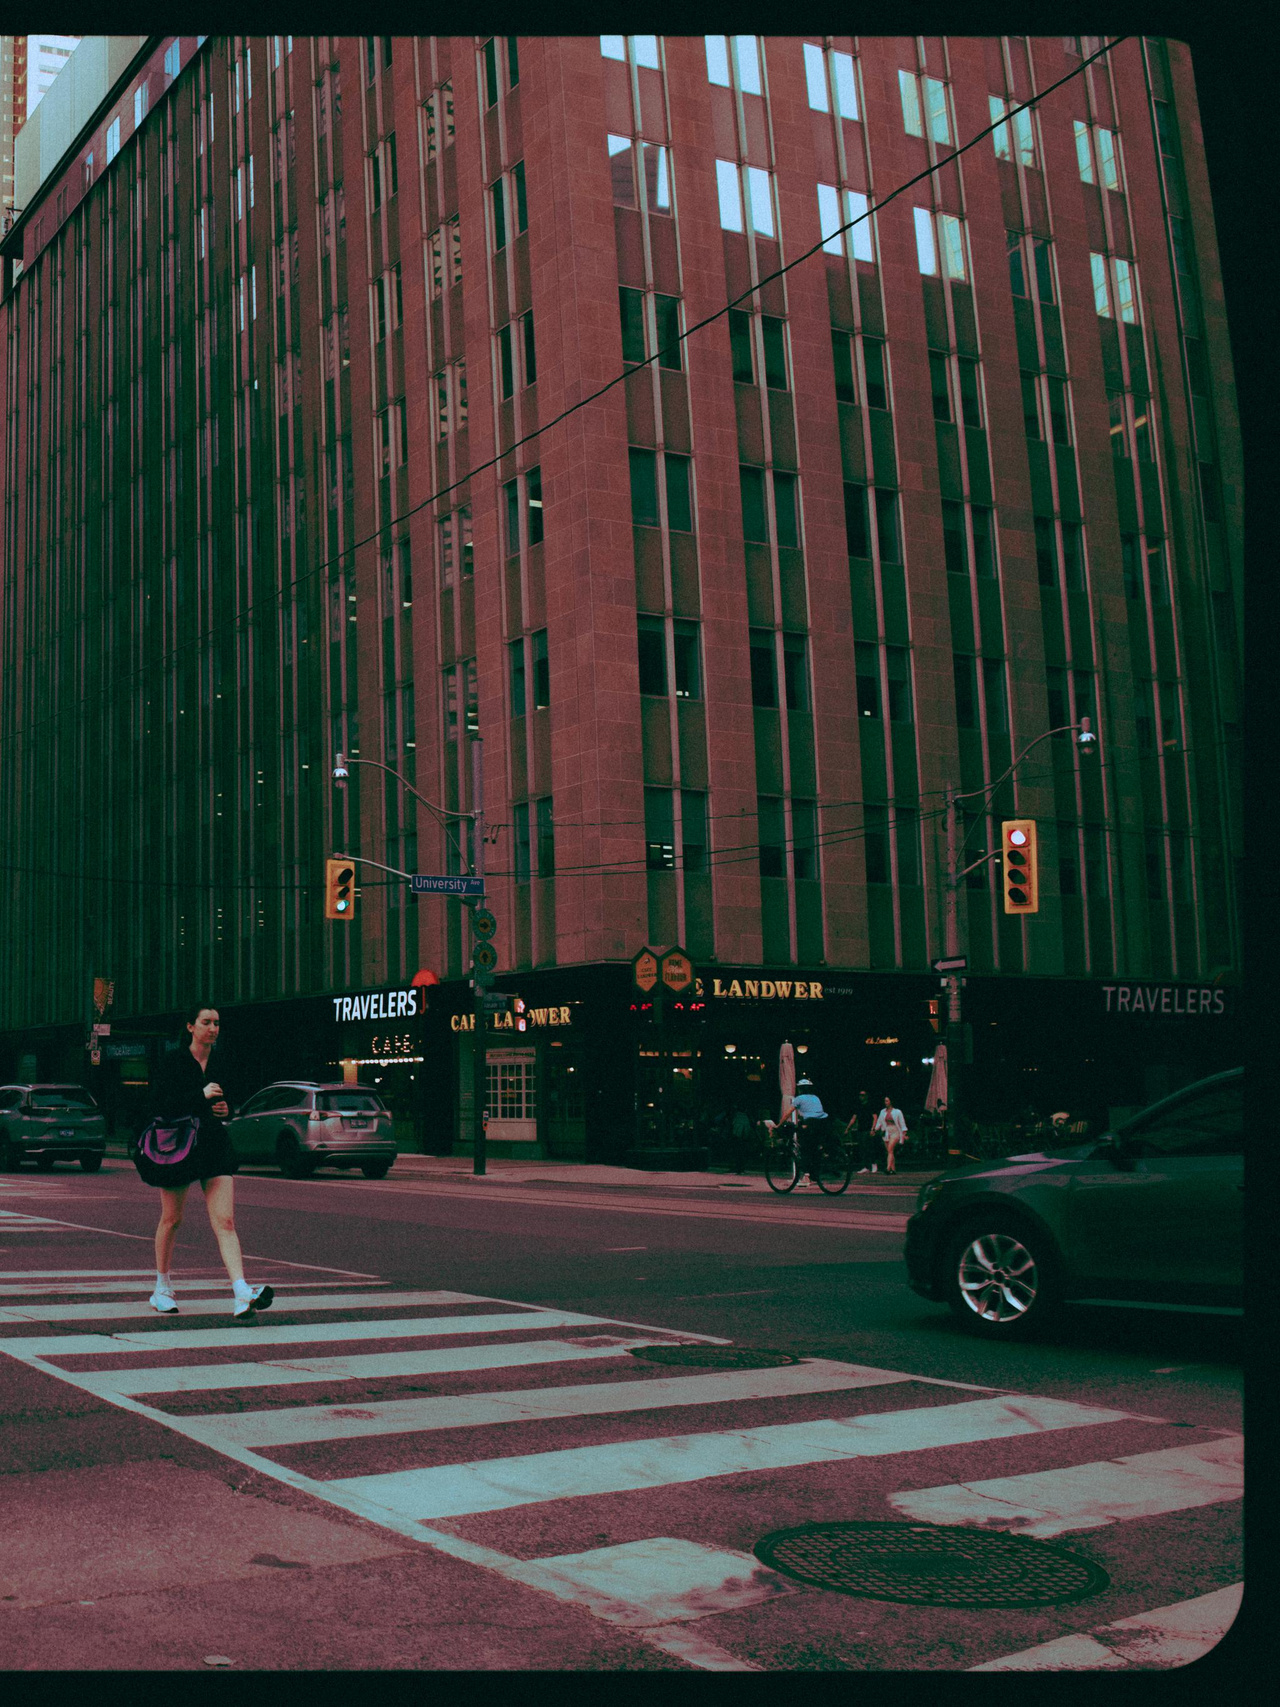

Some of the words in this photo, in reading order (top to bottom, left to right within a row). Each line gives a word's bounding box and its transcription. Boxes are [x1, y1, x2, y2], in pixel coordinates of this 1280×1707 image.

[415, 876, 467, 892] University
[713, 978, 825, 1000] LANDWER
[837, 987, 854, 995] 1919
[1101, 986, 1225, 1014] TRAVELERS
[333, 989, 417, 1022] TRAVELERS
[450, 1013, 489, 1032] CAF
[493, 1006, 573, 1030] LADWER
[371, 1034, 411, 1055] CAFE
